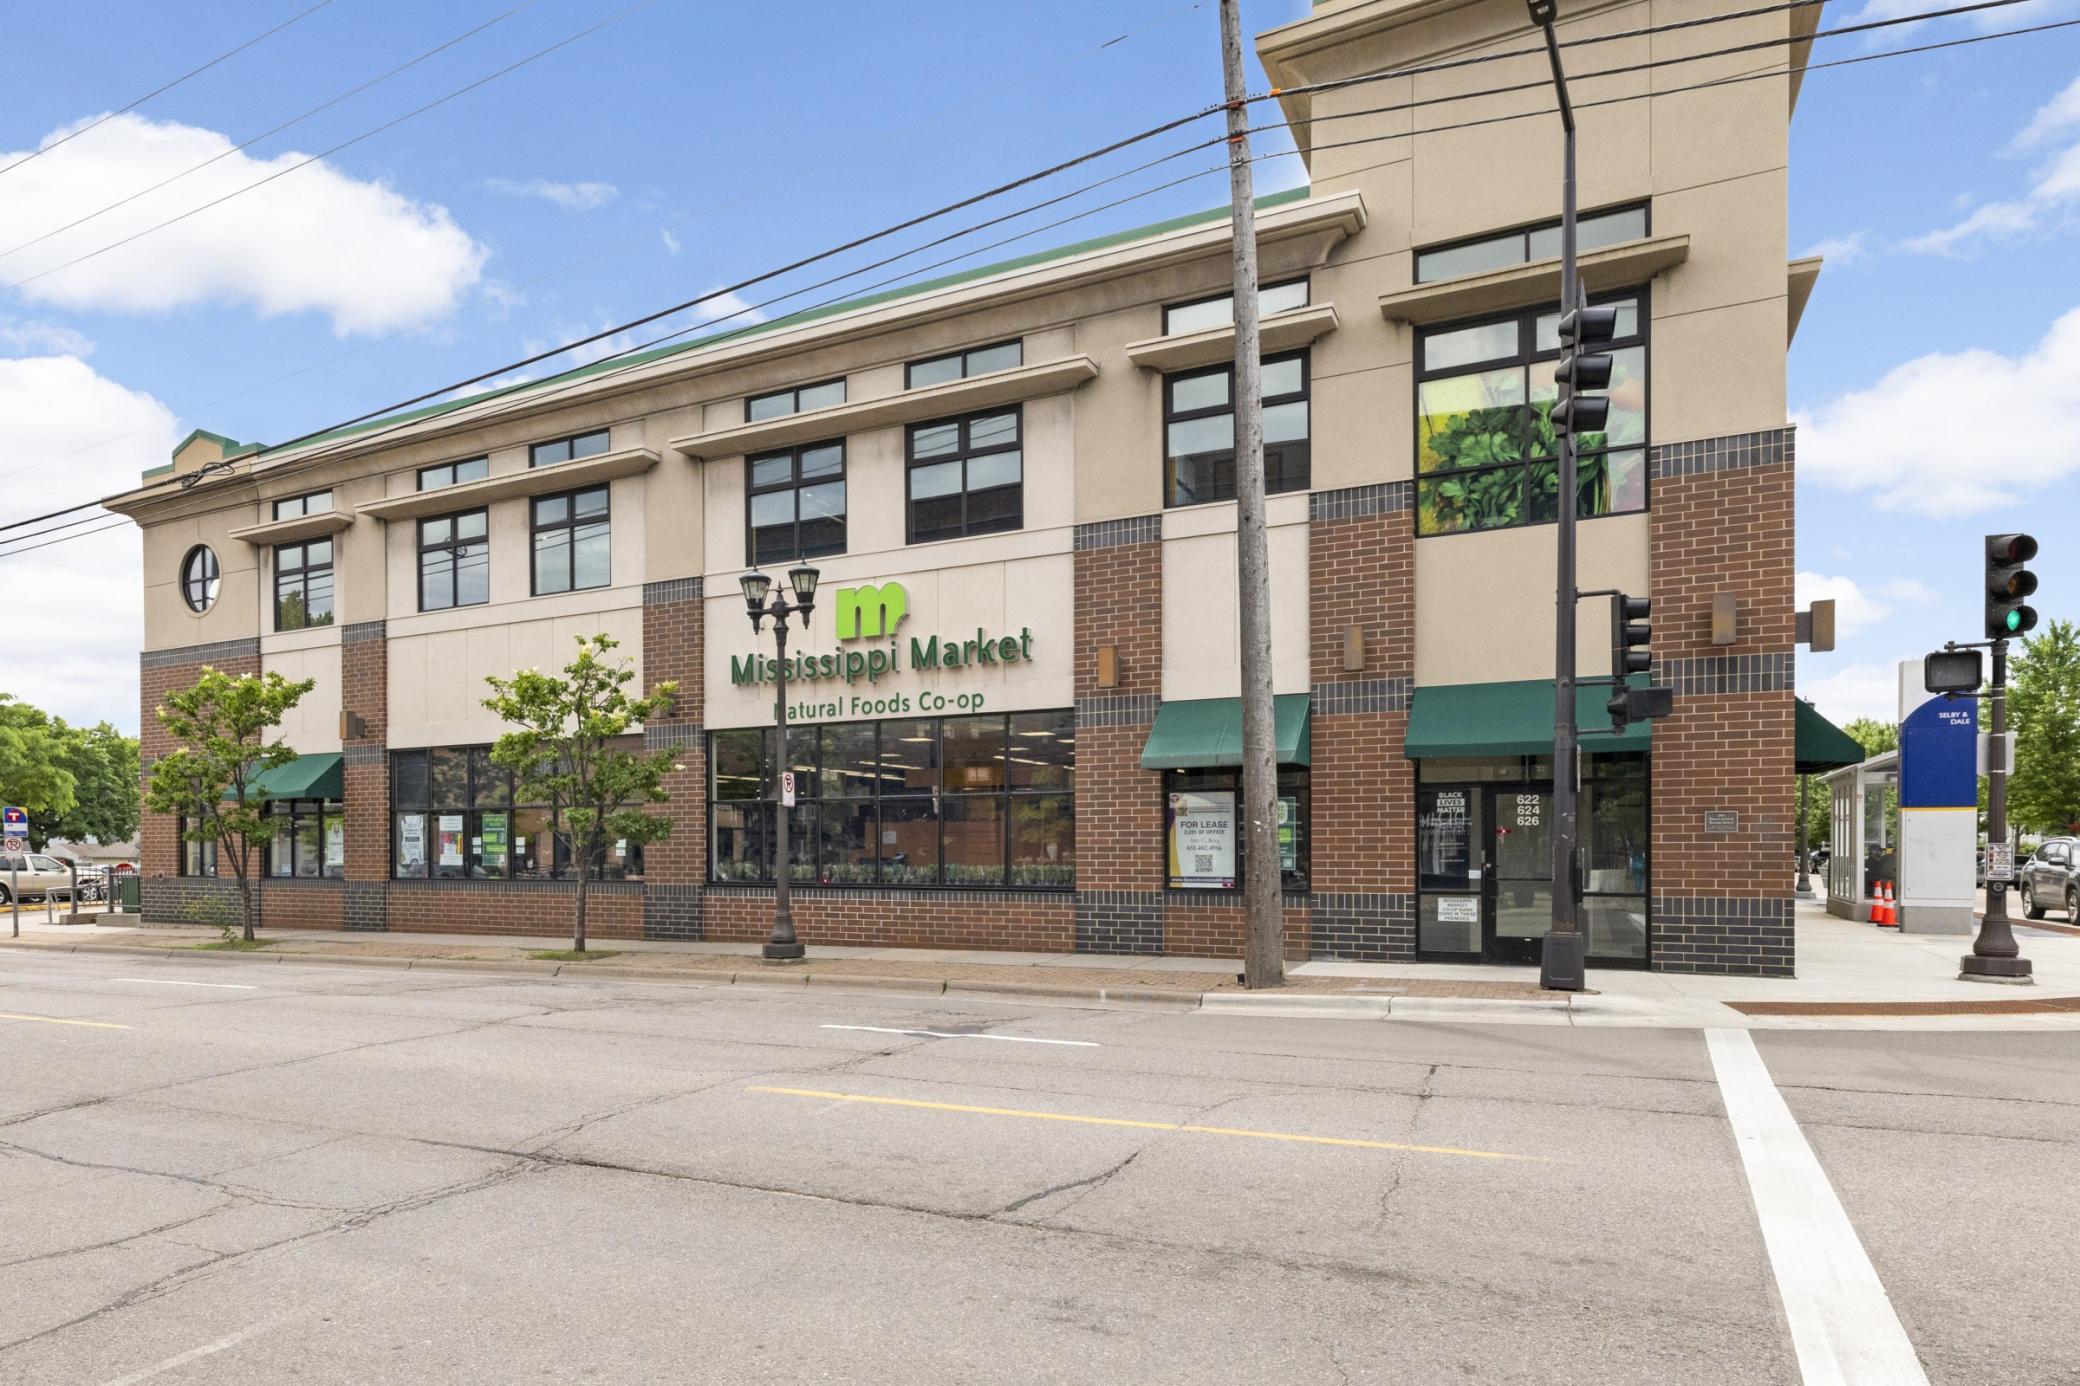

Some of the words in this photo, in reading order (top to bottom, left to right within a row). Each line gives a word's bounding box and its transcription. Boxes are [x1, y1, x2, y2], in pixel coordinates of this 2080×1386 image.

[836, 582, 908, 640] m
[730, 641, 900, 685] Mississippi
[910, 627, 1032, 670] Market
[774, 696, 843, 721] atural
[851, 692, 911, 716] Foods
[919, 691, 984, 713] Co-op
[1938, 711, 1961, 719] SELBY
[1517, 794, 1540, 805] 622
[1517, 805, 1540, 815] 624
[1180, 821, 1198, 829] FOR
[1200, 821, 1229, 829] LEASE
[1517, 816, 1540, 826] 626
